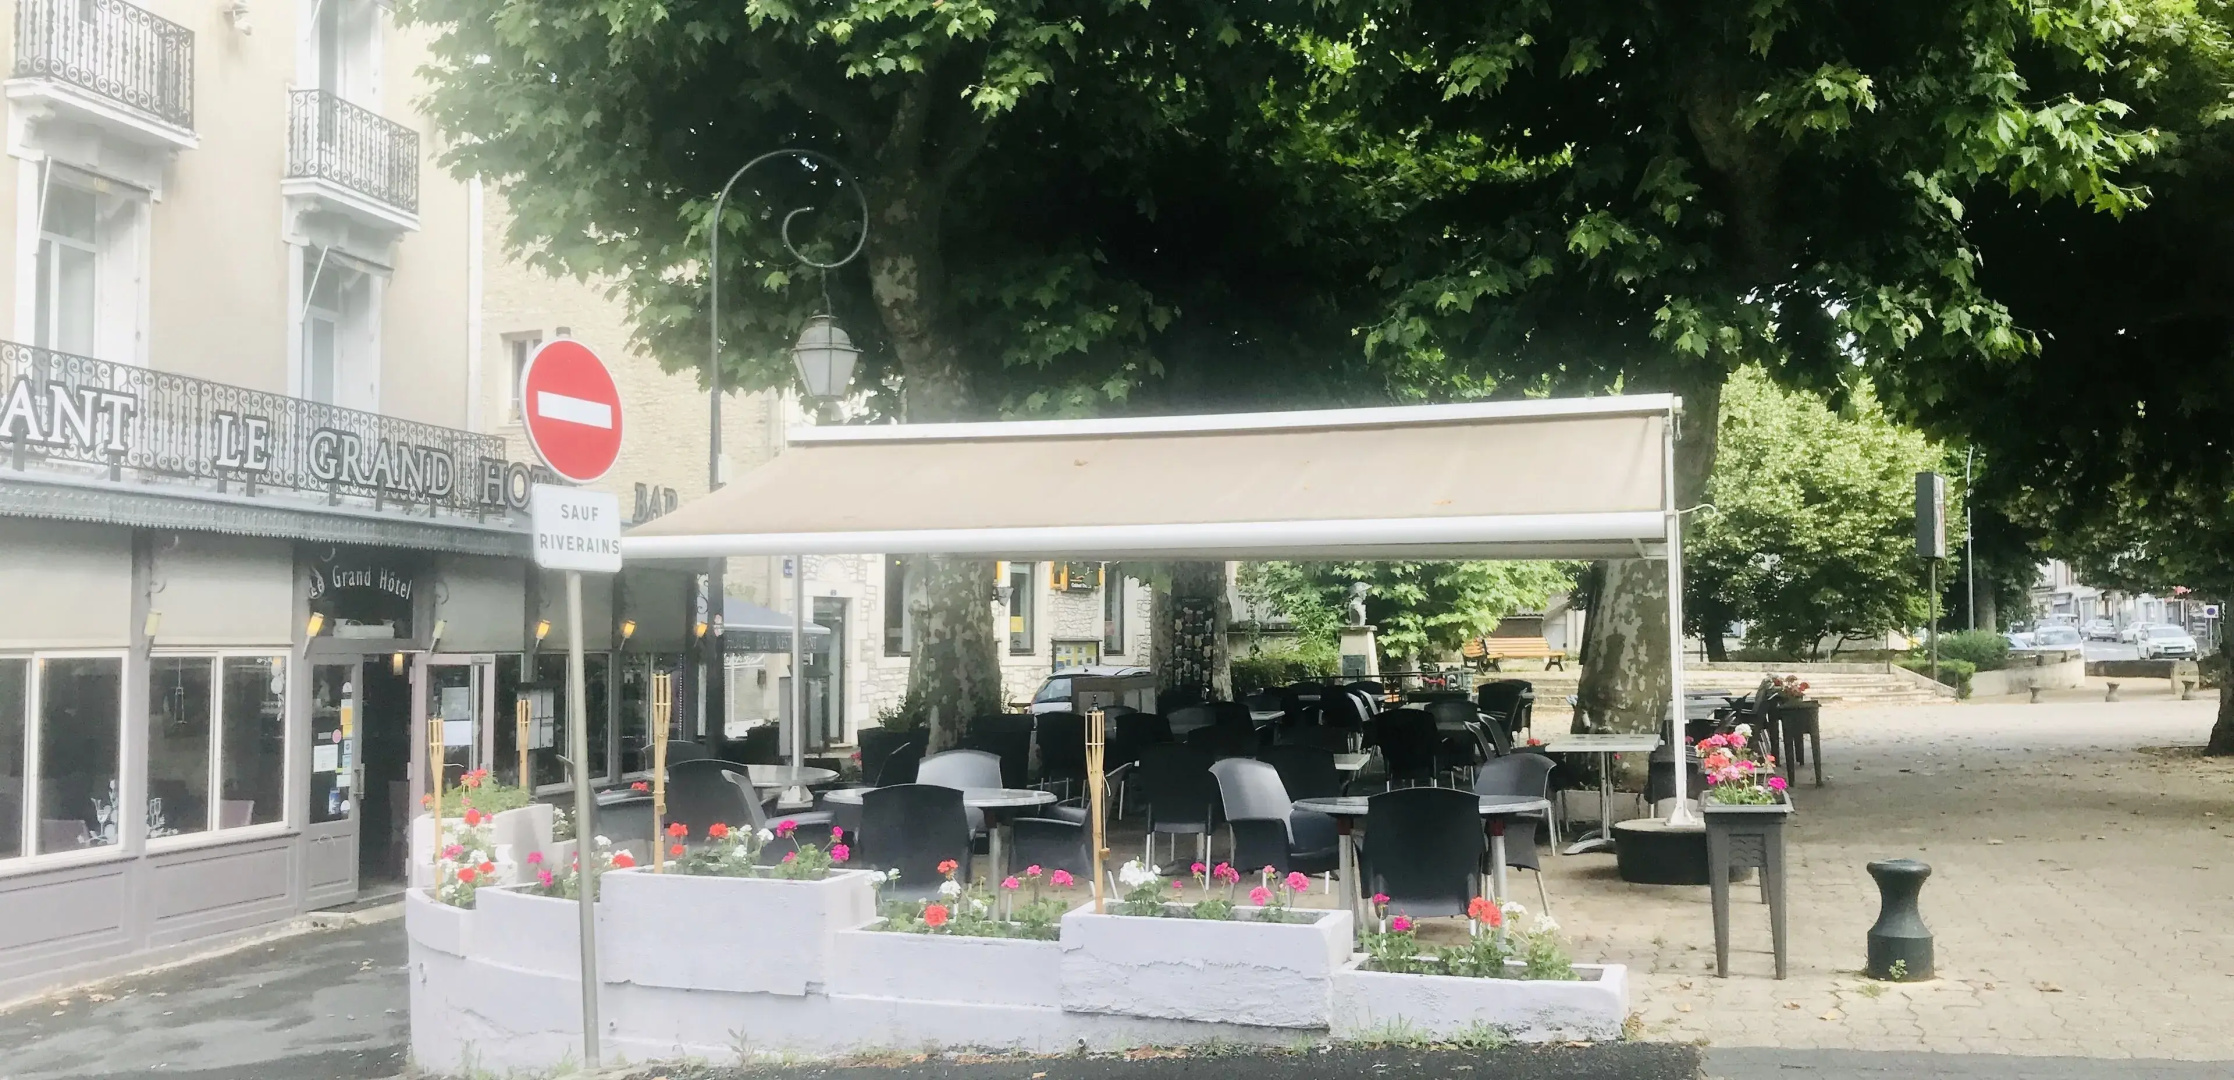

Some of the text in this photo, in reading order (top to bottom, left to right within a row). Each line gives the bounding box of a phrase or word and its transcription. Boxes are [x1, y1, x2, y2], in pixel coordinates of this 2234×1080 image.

[214, 410, 271, 474] LE
[308, 427, 457, 500] GRAND
[632, 482, 679, 524] BAR
[561, 503, 599, 522] SAUF
[539, 533, 620, 556] RIVERAINS
[332, 564, 371, 588] Grand
[379, 567, 412, 600] Hôtel
